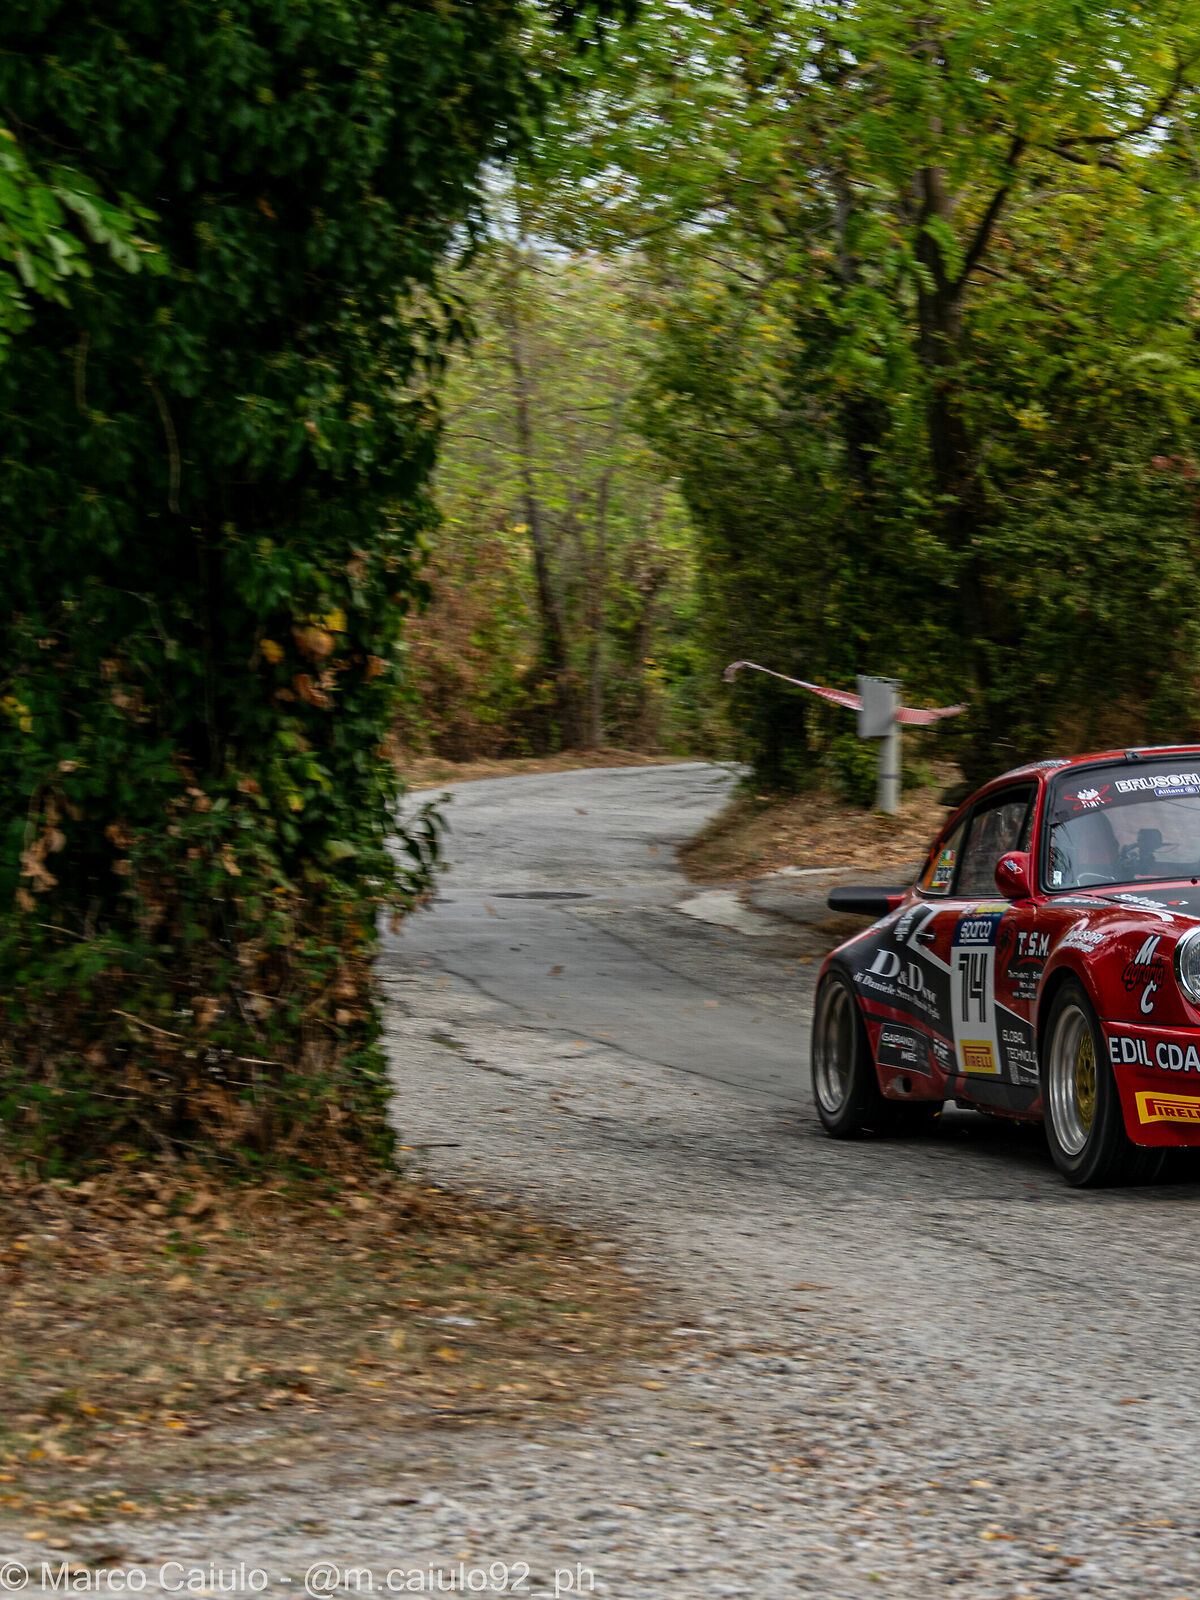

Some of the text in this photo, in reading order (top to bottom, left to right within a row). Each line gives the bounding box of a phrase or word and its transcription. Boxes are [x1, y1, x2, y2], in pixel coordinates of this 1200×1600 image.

[1115, 774, 1200, 793] BRUSORI
[1158, 788, 1185, 796] Allianz
[960, 921, 993, 940] sparco
[957, 952, 988, 1023] 14
[963, 1044, 993, 1069] PIRELLI
[1108, 1036, 1154, 1067] EDIL
